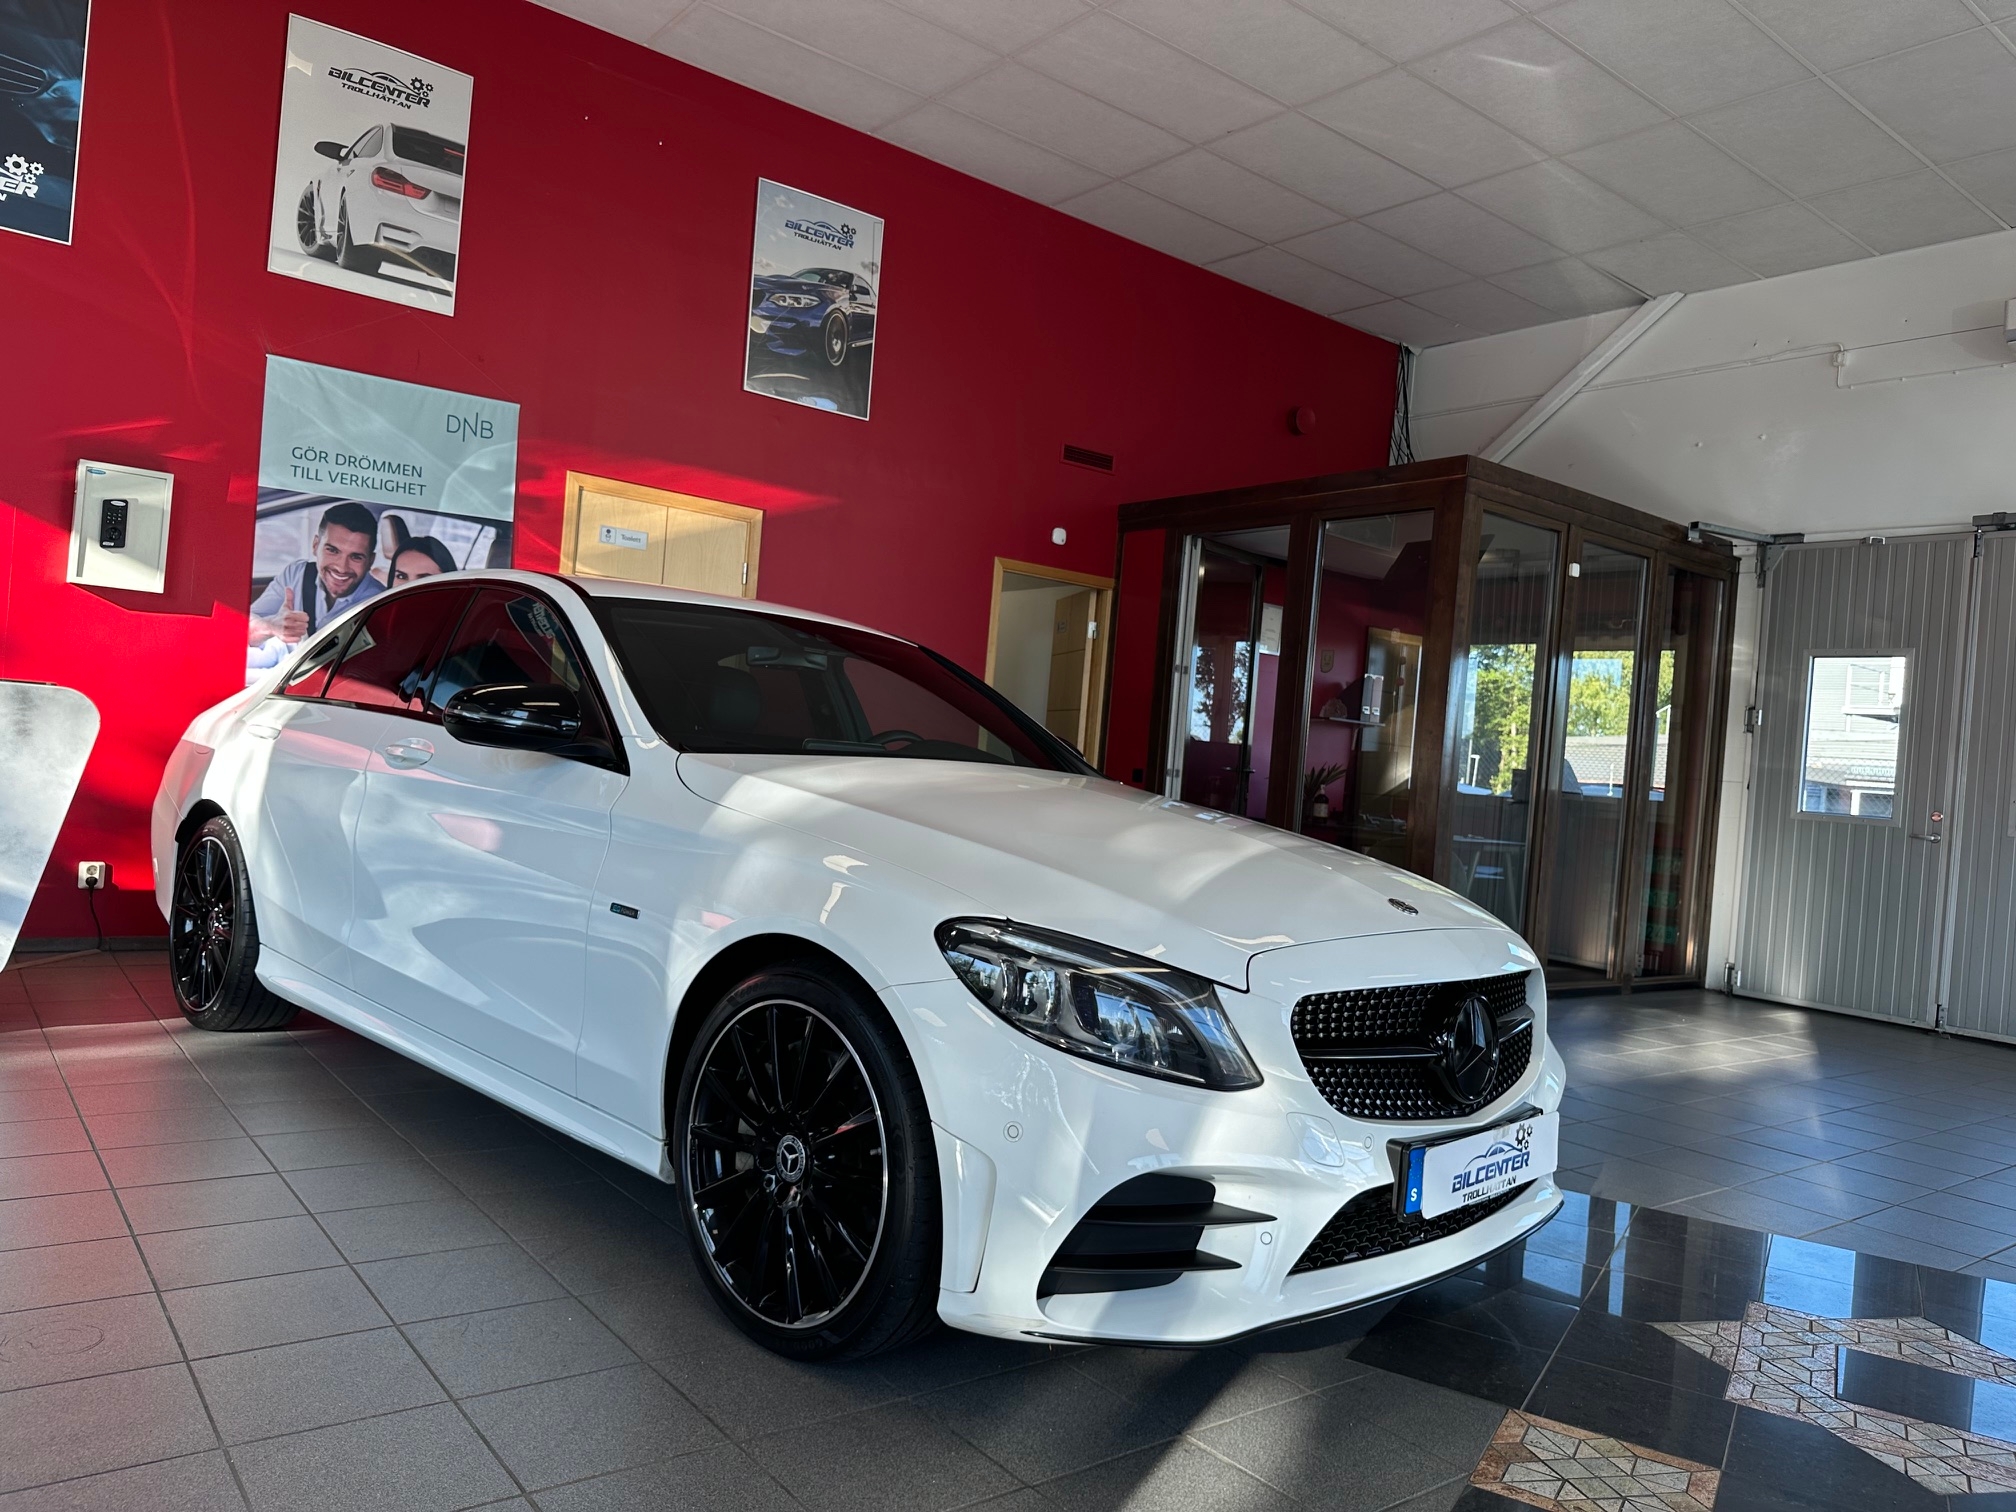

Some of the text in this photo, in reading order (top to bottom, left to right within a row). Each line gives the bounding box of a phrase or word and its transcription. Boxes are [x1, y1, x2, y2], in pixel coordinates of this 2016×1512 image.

[328, 67, 431, 108] BILCENTER
[341, 83, 412, 110] TROLLHÄTTAN
[785, 219, 854, 249] BILCENTER
[446, 412, 494, 442] DNB
[291, 446, 423, 478] GÖR DRÖMMEN
[290, 464, 427, 496] TILL VERKLIGHET
[1451, 1150, 1531, 1194] BILCENTER
[1410, 1188, 1418, 1202] S
